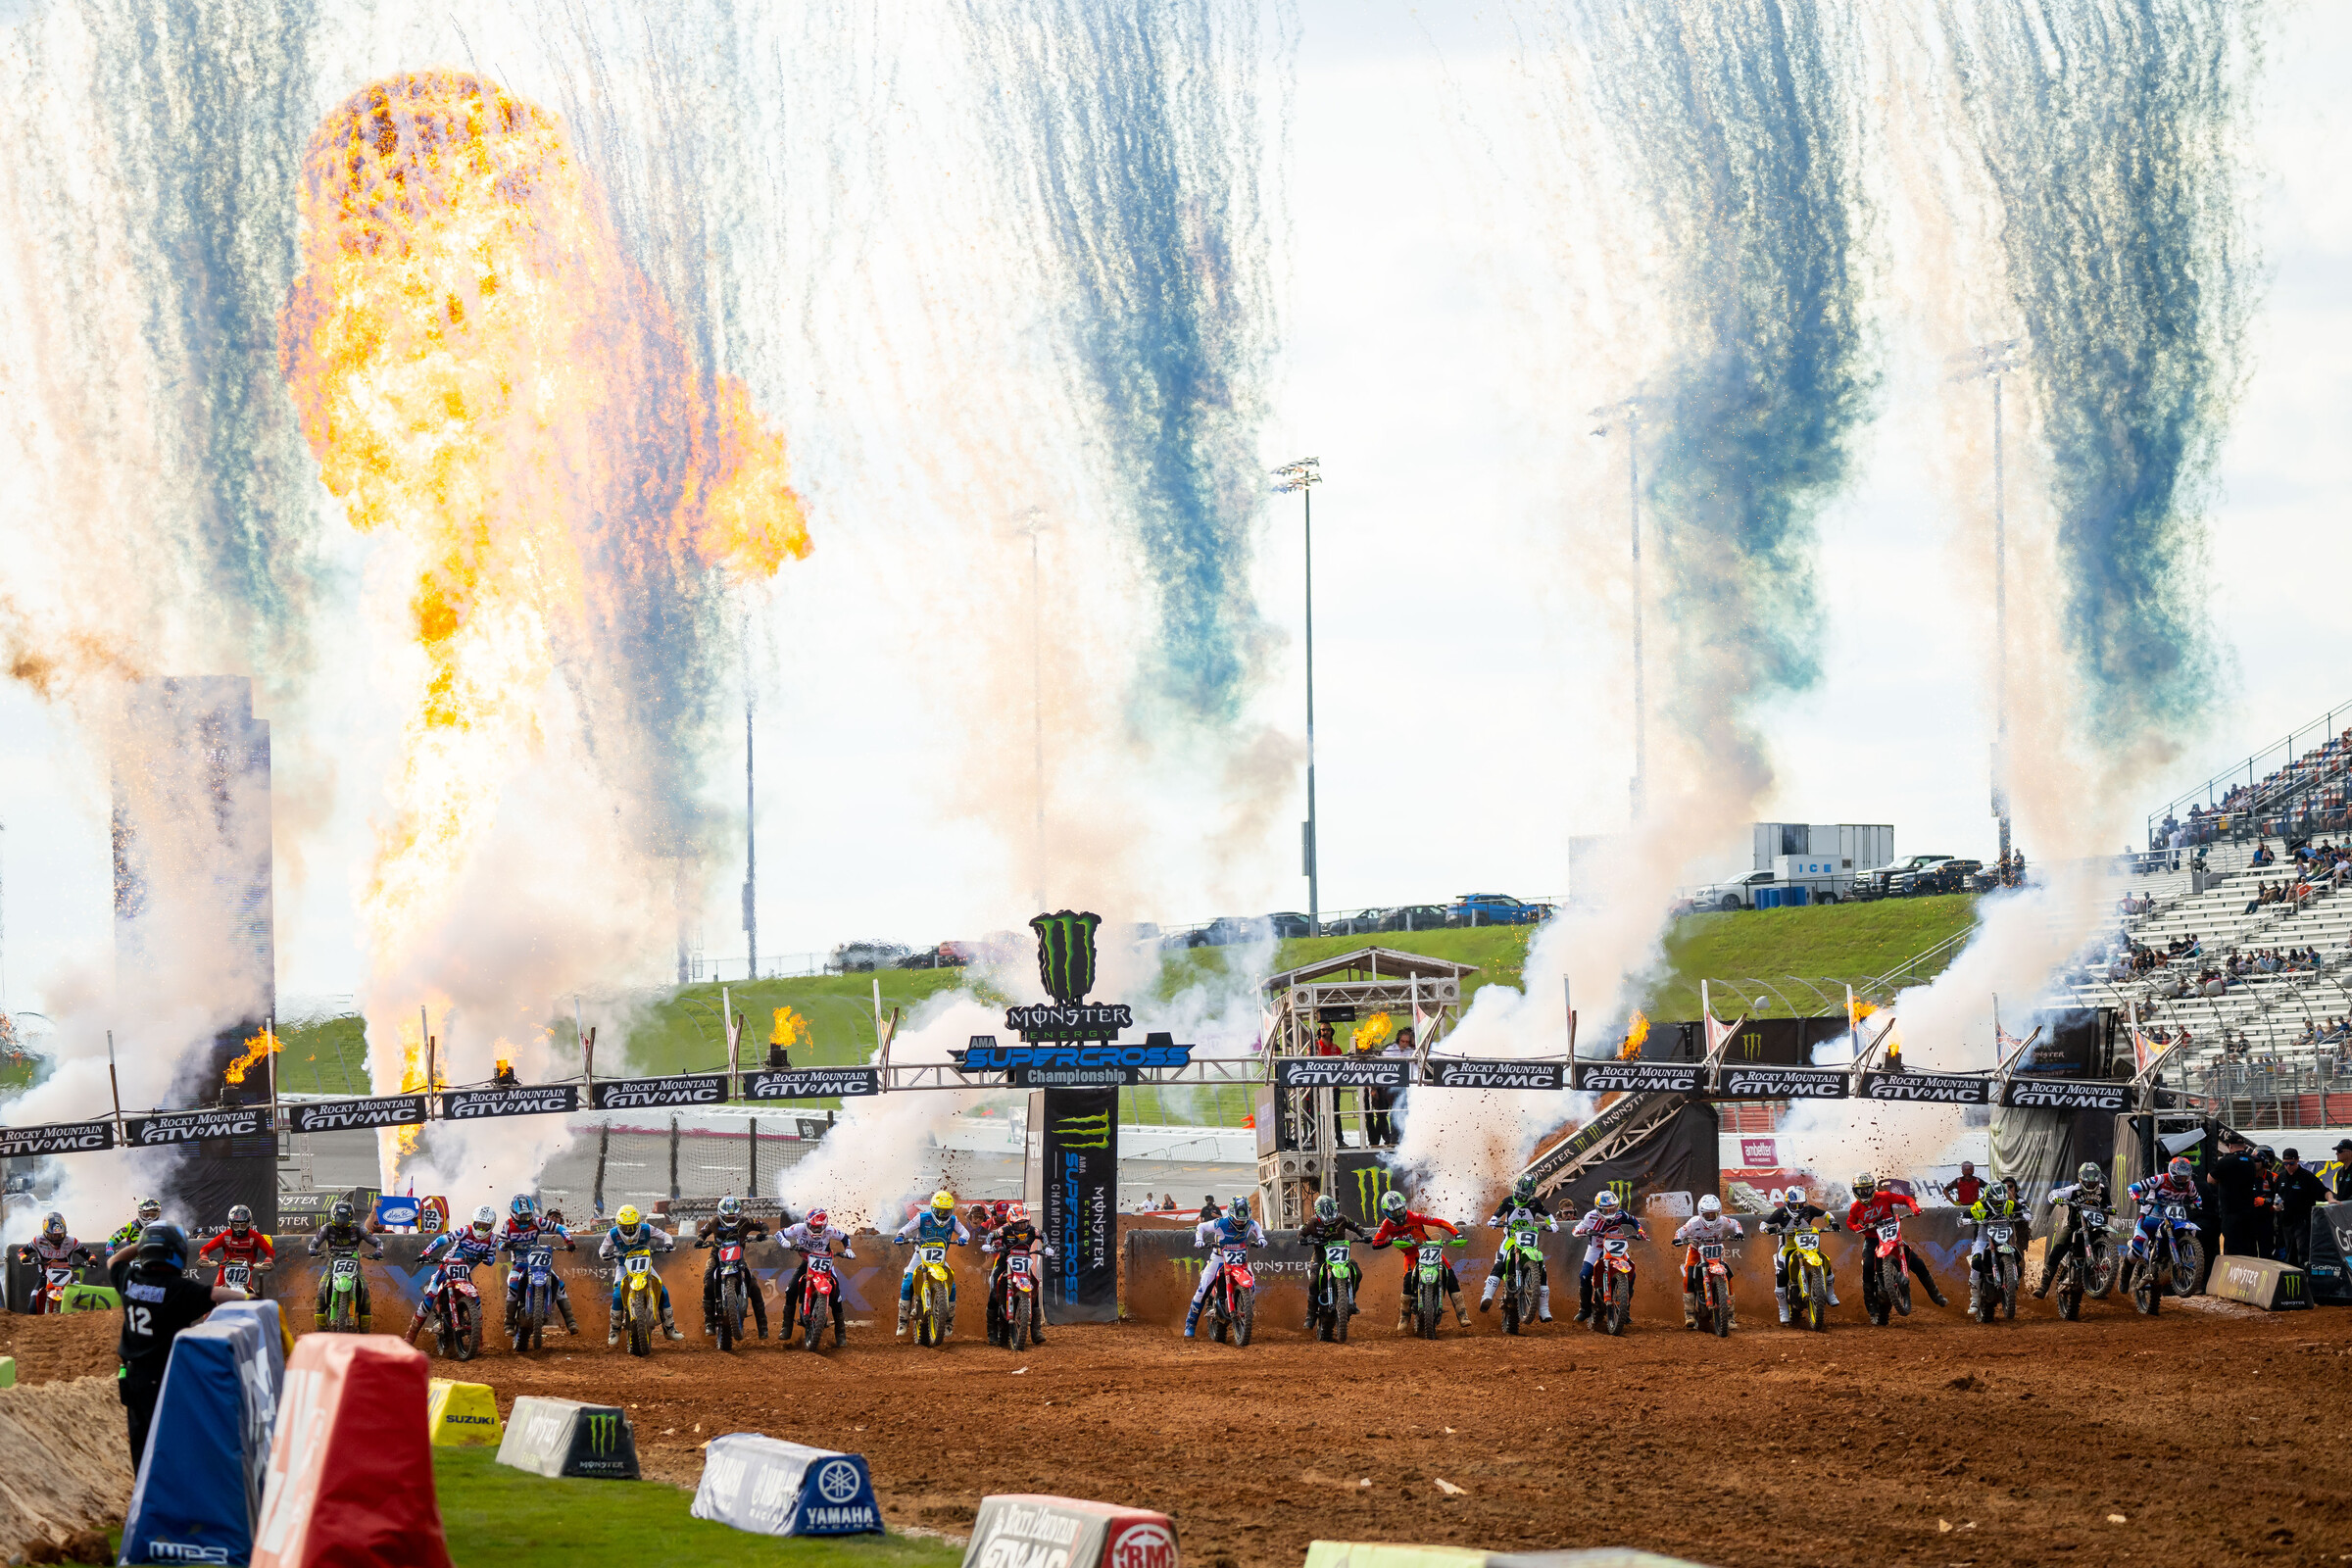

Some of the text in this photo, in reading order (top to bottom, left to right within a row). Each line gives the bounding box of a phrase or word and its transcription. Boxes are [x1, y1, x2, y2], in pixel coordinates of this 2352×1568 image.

[1799, 863, 1832, 873] ICE
[1010, 1006, 1129, 1027] MONSTER
[1030, 1029, 1111, 1039] ENERGY
[971, 1037, 996, 1048] AMA
[963, 1048, 1190, 1067] SUPERCROSS
[1304, 1061, 1400, 1072] ROCKY MOUNTAIN
[1459, 1062, 1555, 1074] ROCKY MOUNTAIN
[1601, 1066, 1696, 1077] ROCKY MOUNTAIN
[771, 1071, 868, 1083] ROCKY MOUNTAIN
[1028, 1068, 1127, 1085] Championship
[1746, 1071, 1841, 1083] ROCKY MOUNTAIN
[1887, 1075, 1981, 1089] ROCKY MOUNTAIN
[621, 1079, 718, 1093] ROCKY MOUNTAIN
[2030, 1083, 2124, 1096] ROCKY MOUNTAIN
[468, 1089, 566, 1102] ROCKY MOUNTAIN
[318, 1099, 416, 1115] ROCKY MOUNTAIN
[159, 1111, 257, 1128] ROCKY MOUNTAIN
[6, 1125, 104, 1141] ROCKY MOUNTAIN
[1744, 1142, 1772, 1156] ambetter
[425, 1209, 437, 1229] 519
[1863, 1205, 1883, 1221] FLY
[2087, 1212, 2103, 1224] 46
[2169, 1206, 2184, 1218] 44
[1051, 1183, 1060, 1273] CHAMPIONSHIP
[1065, 1151, 1078, 1305] SUPERCROSS
[1092, 1186, 1104, 1269] MONSTER
[1881, 1225, 1897, 1240] 15
[1989, 1229, 2011, 1240] 751
[461, 1238, 491, 1252] FXR
[1520, 1233, 1536, 1247] 9
[1800, 1236, 1817, 1247] 94
[725, 1247, 735, 1260] 1
[1328, 1248, 1348, 1261] 21
[1610, 1242, 1625, 1253] 2
[1703, 1246, 1722, 1258] 80
[529, 1252, 552, 1266] 78
[925, 1250, 942, 1261] 12
[1227, 1251, 1247, 1264] 23
[1421, 1249, 1441, 1261] 47
[334, 1260, 357, 1274] 68
[631, 1258, 647, 1271] 11
[811, 1258, 830, 1272] 45
[1011, 1258, 1029, 1272] 51
[52, 1270, 70, 1284] 7
[226, 1269, 247, 1283] 412
[450, 1265, 467, 1279] 60
[2229, 1264, 2259, 1287] MONSTER
[127, 1304, 153, 1335] 12
[446, 1414, 495, 1425] SUZUKI
[579, 1459, 625, 1469] MONSTER
[807, 1507, 874, 1526] YAMAHA
[1126, 1544, 1167, 1568] RM
